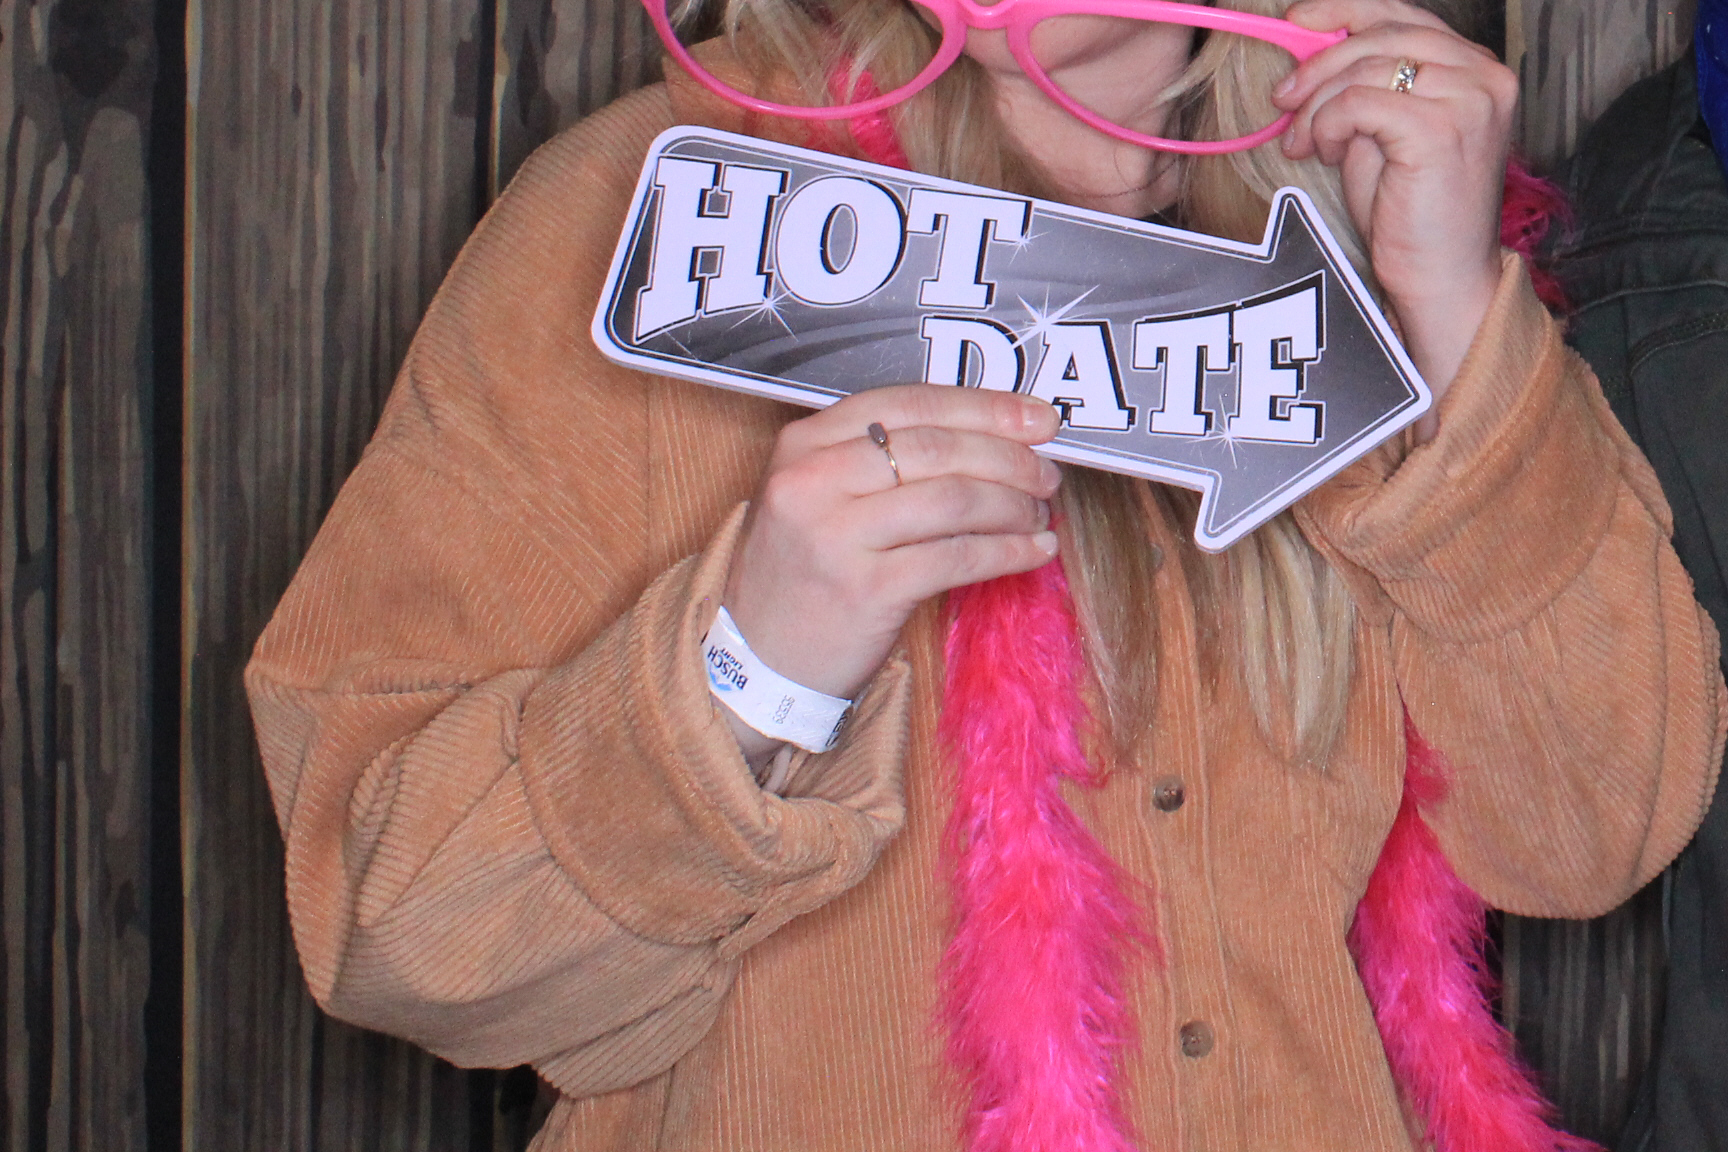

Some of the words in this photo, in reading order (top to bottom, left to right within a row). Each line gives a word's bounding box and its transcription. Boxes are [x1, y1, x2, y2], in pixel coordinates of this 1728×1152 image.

[635, 156, 1033, 344] HOT
[921, 270, 1327, 444] DATE
[707, 645, 749, 690] BUSCH
[719, 647, 744, 671] LIGHT
